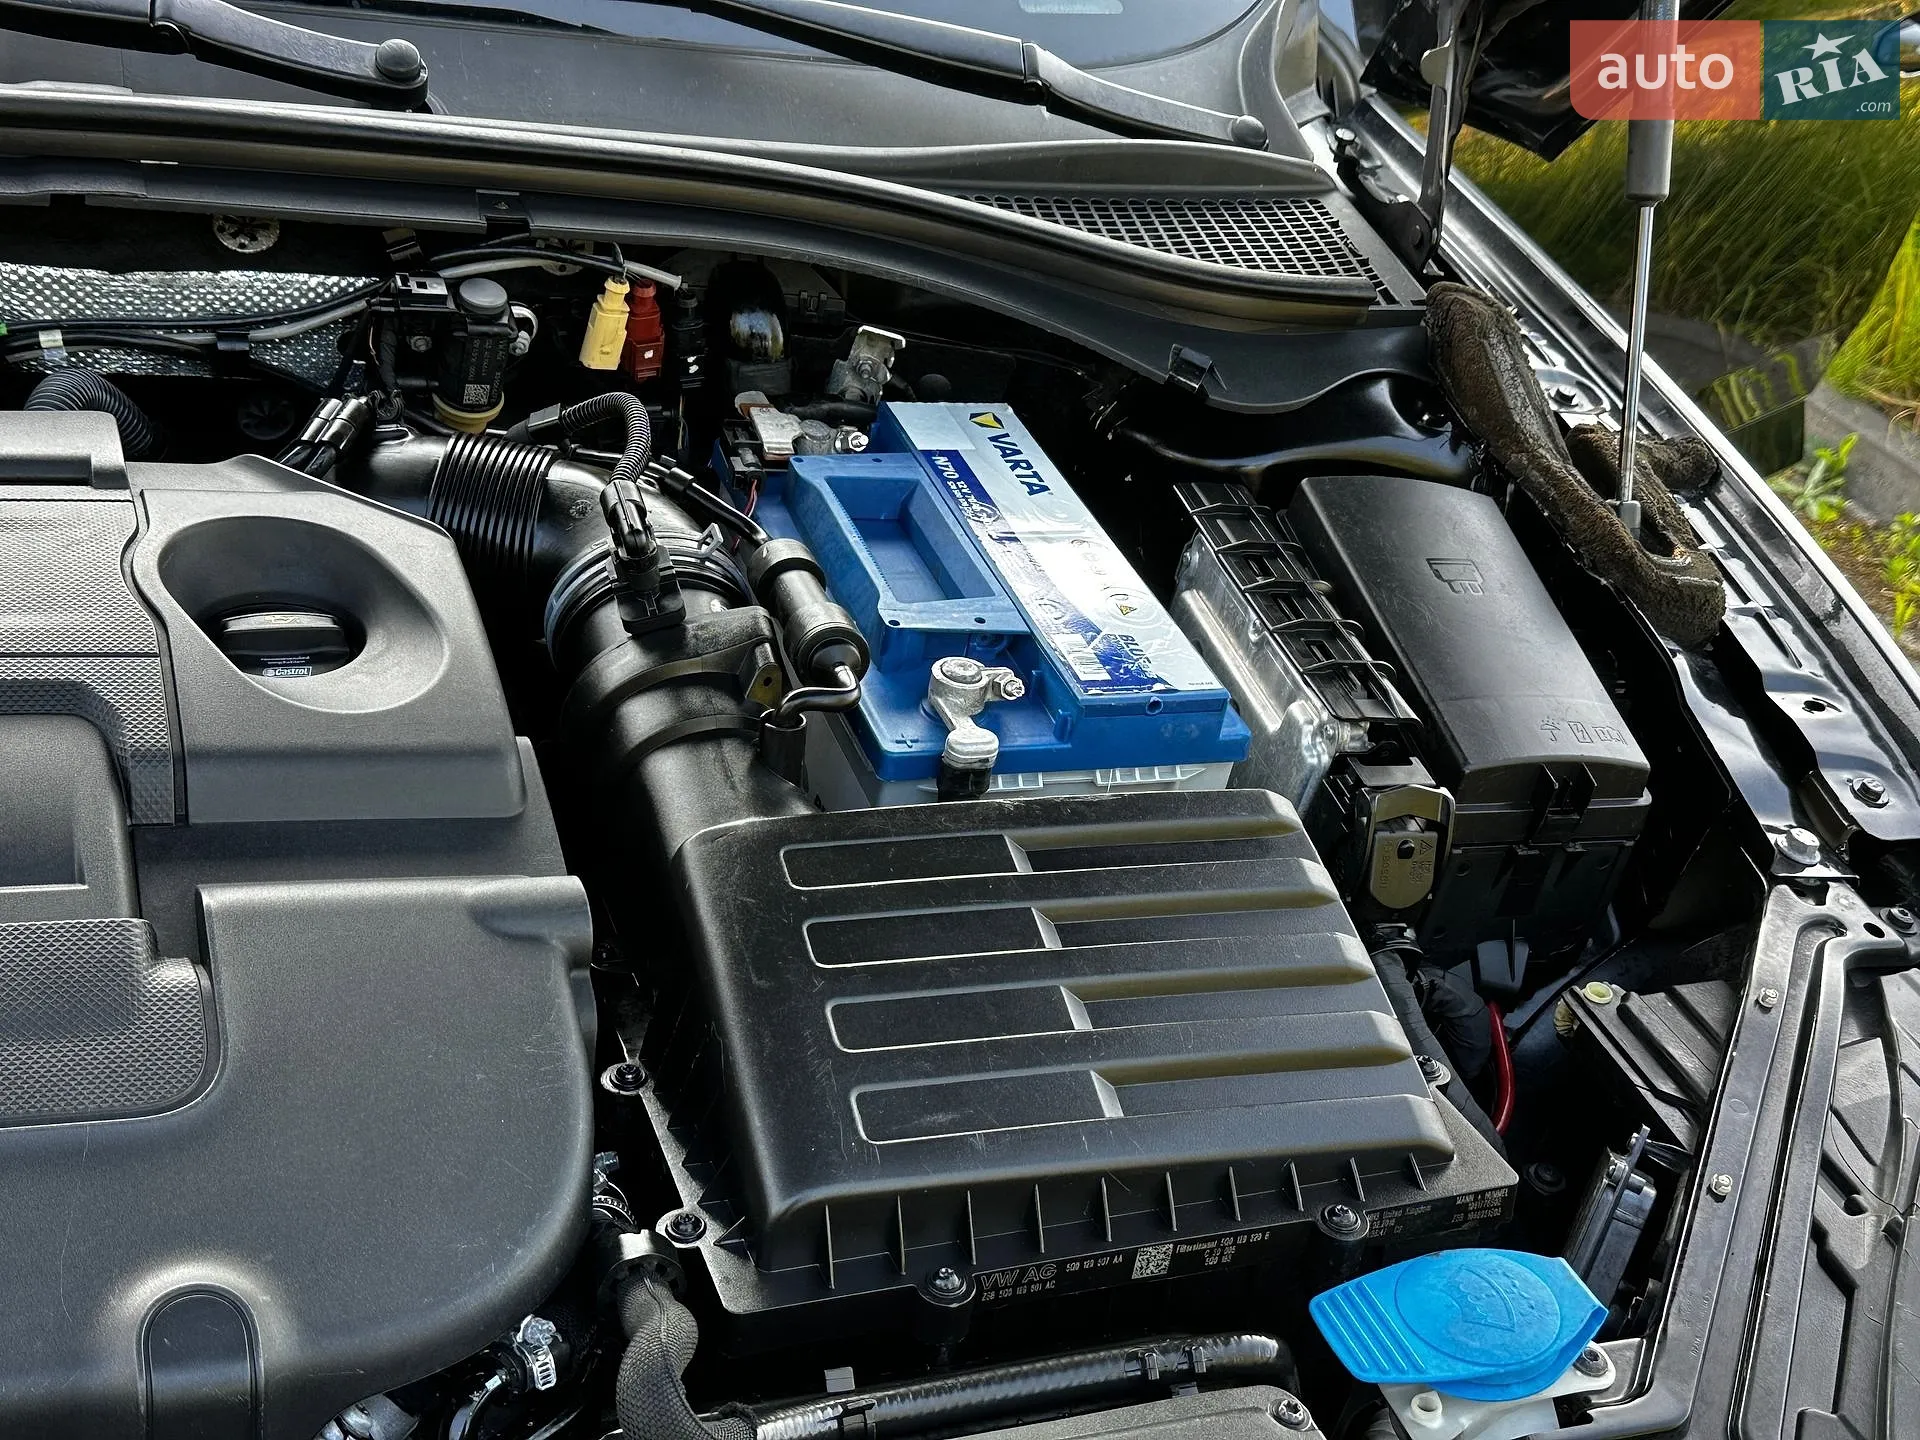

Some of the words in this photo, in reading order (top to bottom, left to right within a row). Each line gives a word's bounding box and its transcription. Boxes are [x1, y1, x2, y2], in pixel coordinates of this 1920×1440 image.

[932, 456, 960, 479] N70
[987, 432, 1051, 496] VARTA
[275, 667, 308, 676] Castrol
[981, 1269, 1020, 1290] VW
[1022, 1263, 1057, 1284] AG
